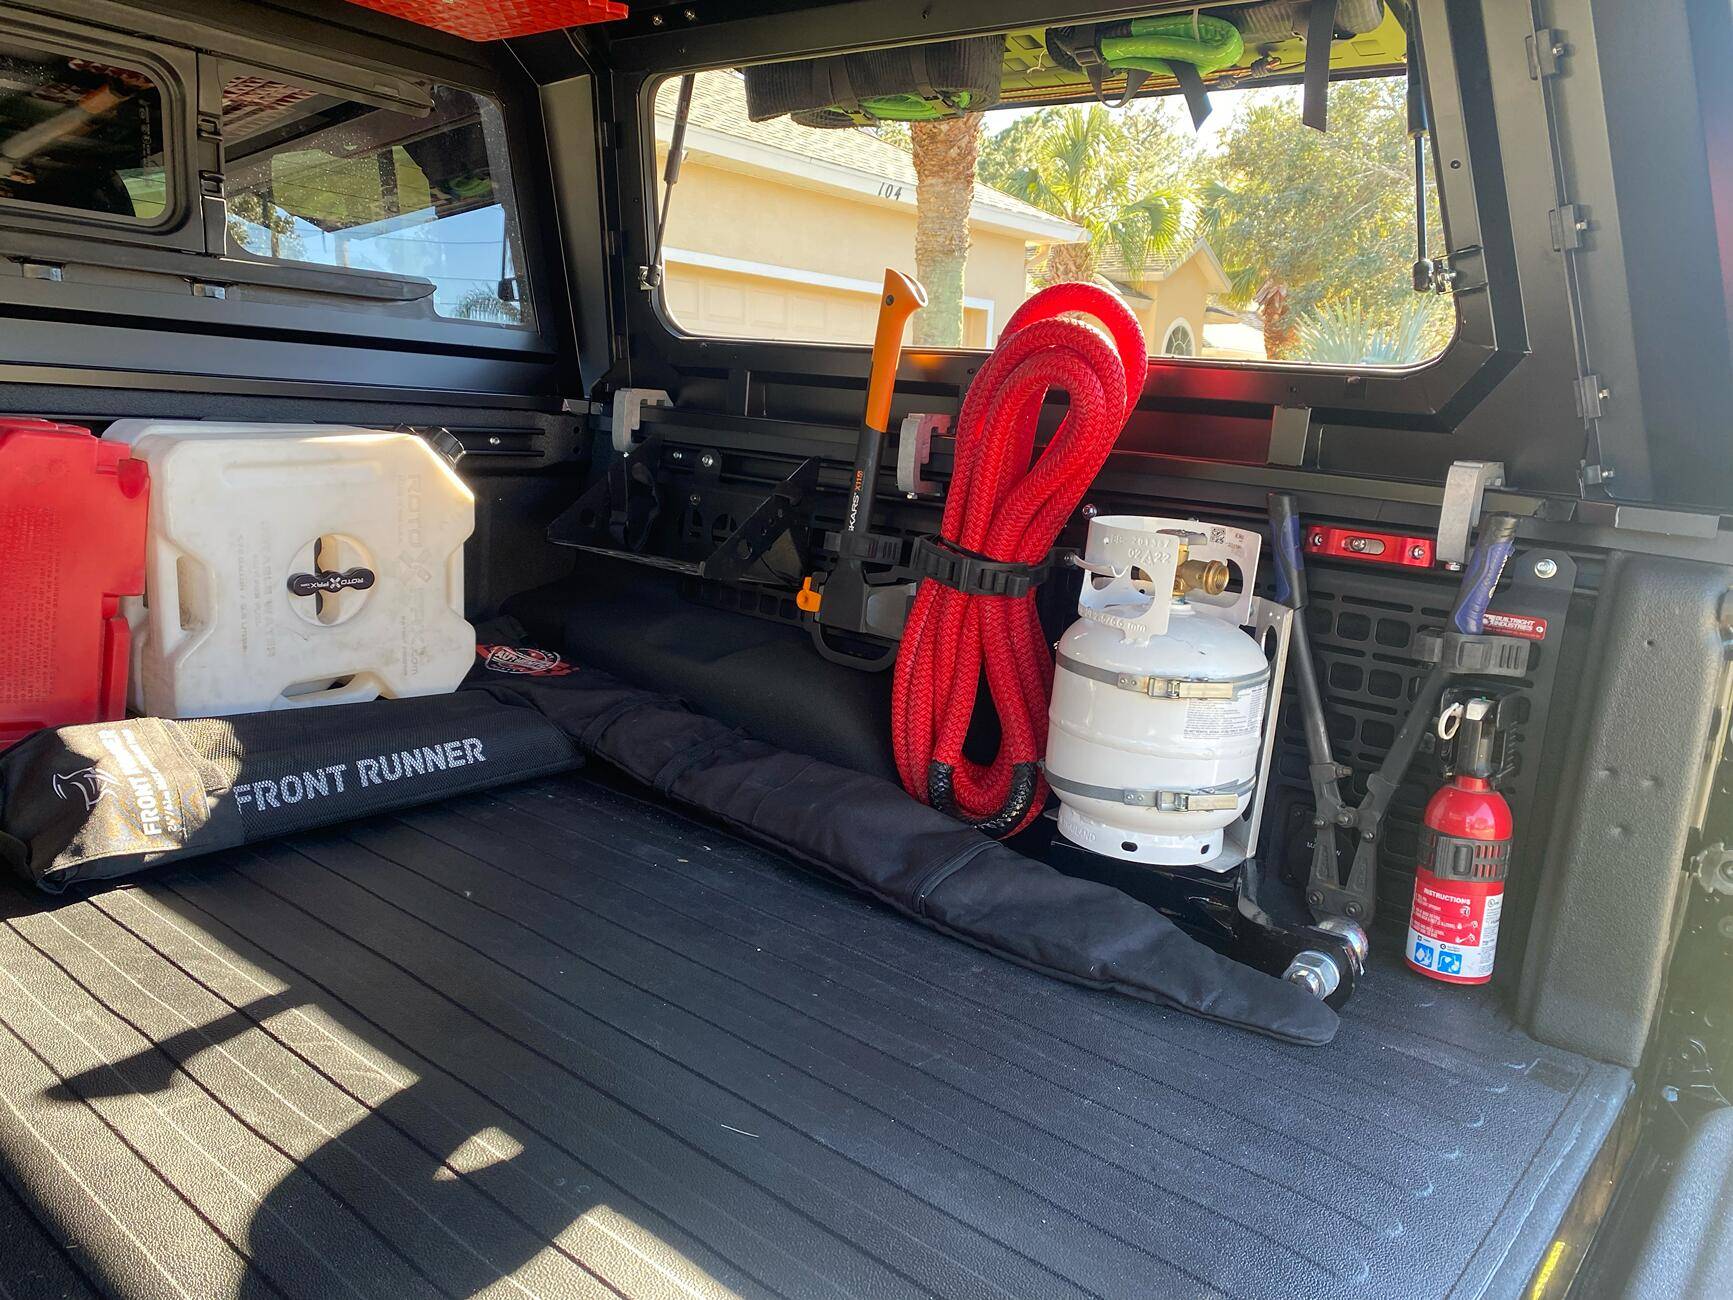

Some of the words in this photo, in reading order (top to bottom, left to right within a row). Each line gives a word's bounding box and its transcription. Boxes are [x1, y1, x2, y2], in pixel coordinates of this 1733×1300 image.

[878, 181, 903, 201] 104
[341, 577, 364, 586] ROTO
[233, 763, 347, 815] FRONT
[356, 737, 487, 788] RUNNER
[126, 777, 163, 836] FRONT
[1423, 887, 1471, 906] INSTRUCTIONS
